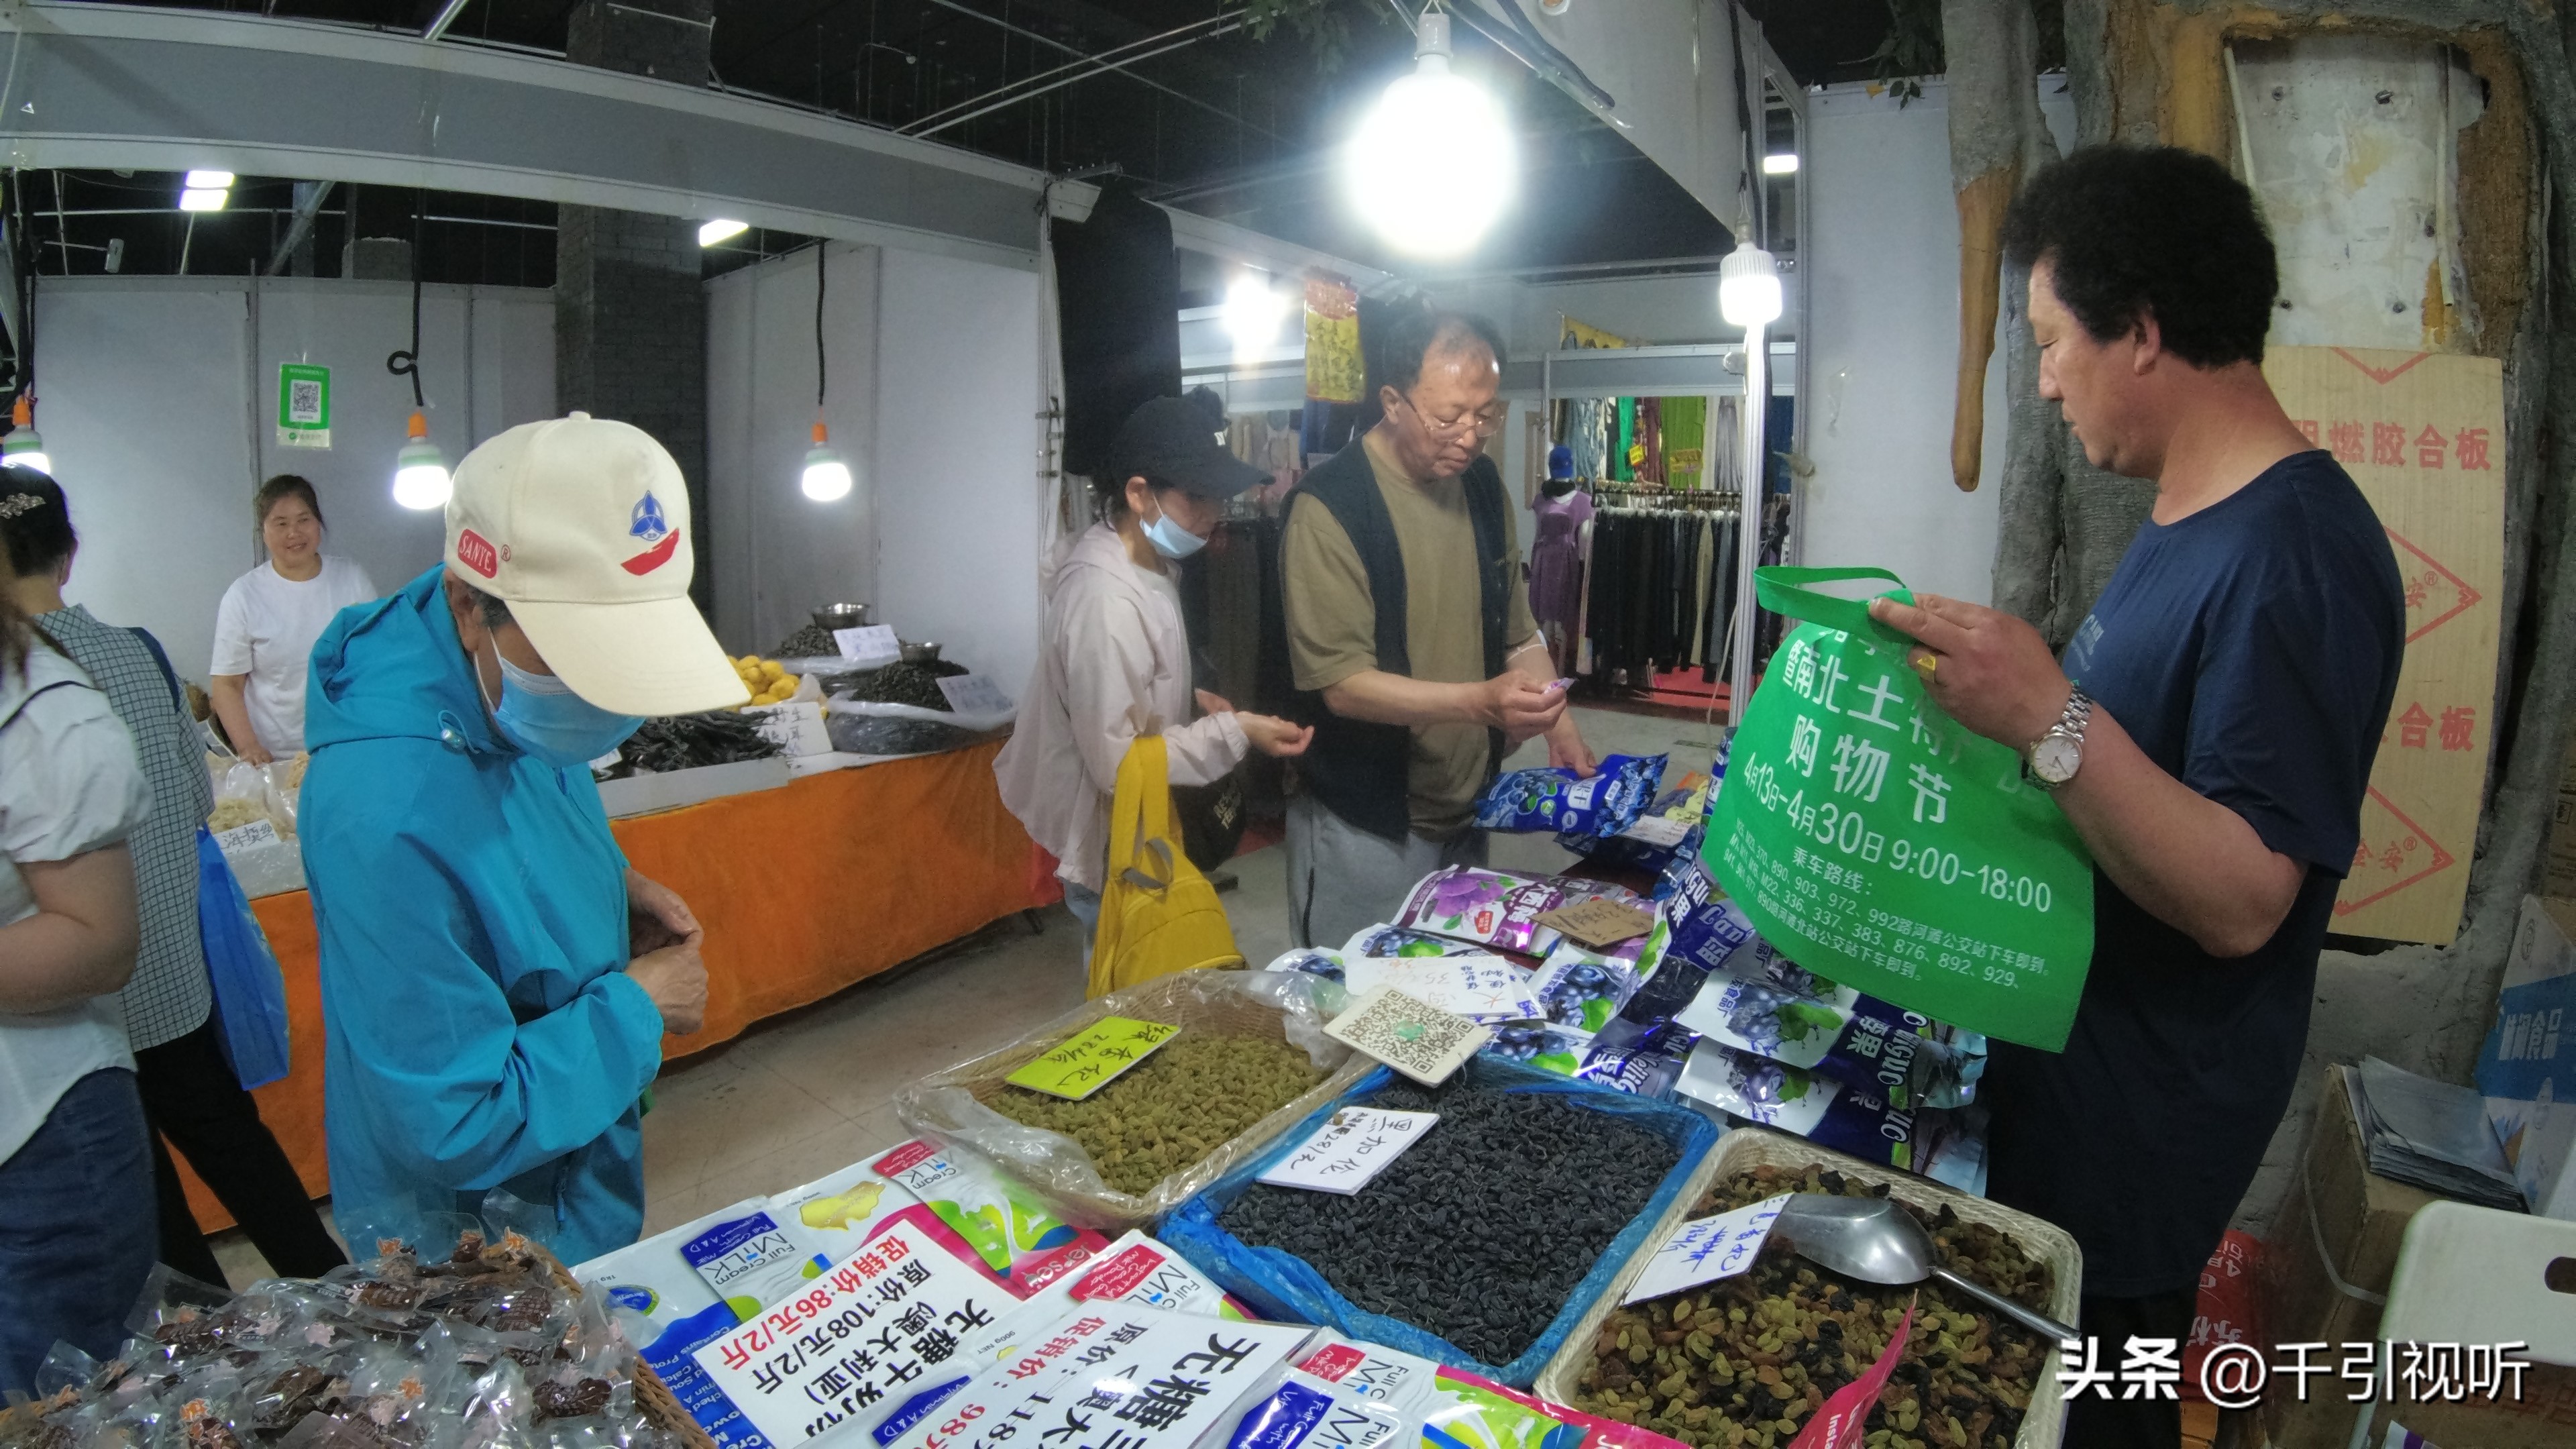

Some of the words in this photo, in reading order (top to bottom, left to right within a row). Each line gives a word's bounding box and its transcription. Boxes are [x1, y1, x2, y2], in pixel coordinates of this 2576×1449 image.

[459, 535, 492, 572] SANYE
[1786, 714, 1951, 824] 购物节
[1888, 839, 2051, 912] 9:00-18:00
[912, 1167, 957, 1189] Cream
[705, 1232, 788, 1279] MiLK
[769, 1244, 796, 1259] Full
[716, 1258, 765, 1285] Cream
[1126, 1265, 1188, 1304] MiL
[720, 1235, 910, 1371] 促销价:86元/2斤
[1179, 1280, 1201, 1300] Full
[752, 1258, 932, 1394] 原价:108元/2斤
[996, 1330, 1016, 1344] 900g
[977, 1342, 994, 1354] NET
[1381, 1366, 1409, 1387] Full
[884, 1425, 896, 1438] D
[1359, 1421, 1391, 1448] Full
